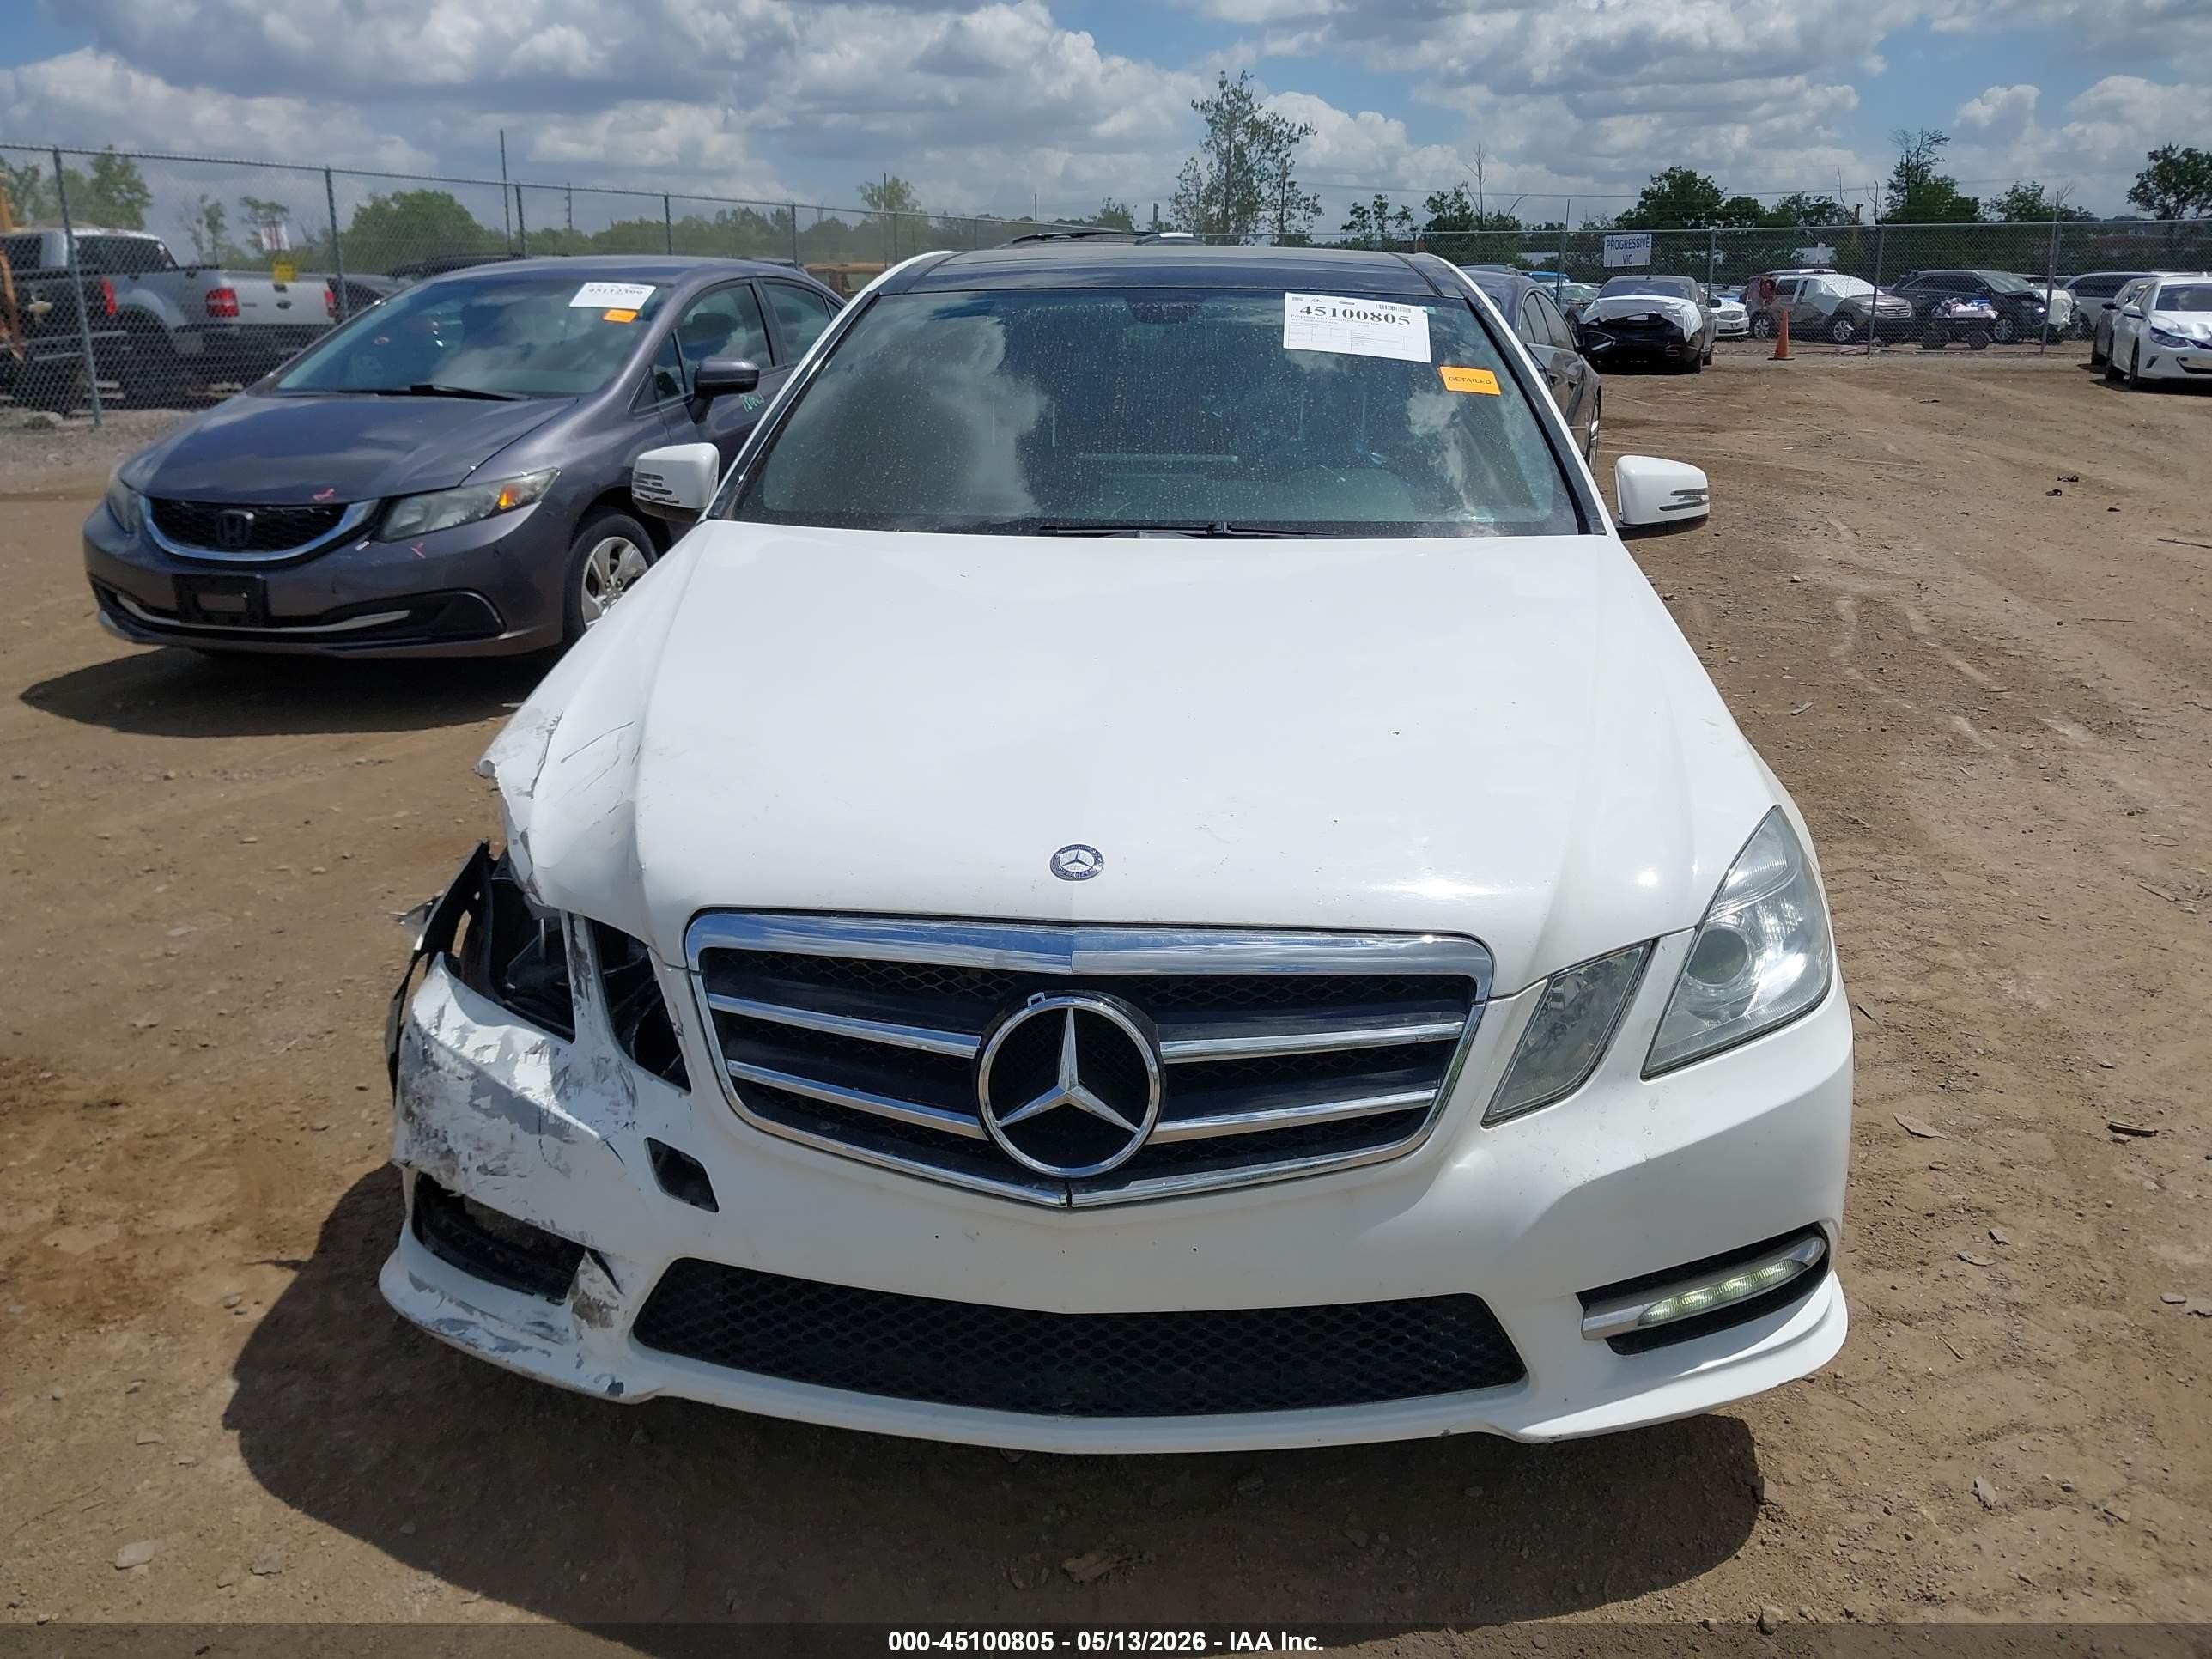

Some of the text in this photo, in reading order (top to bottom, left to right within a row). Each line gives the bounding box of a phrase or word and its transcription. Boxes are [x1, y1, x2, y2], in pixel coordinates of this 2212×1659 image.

[1607, 238, 1650, 250] PROGRESSIVE
[1623, 254, 1633, 264] VIC
[1299, 306, 1411, 325] 45100805
[1448, 376, 1492, 385] DETAILED
